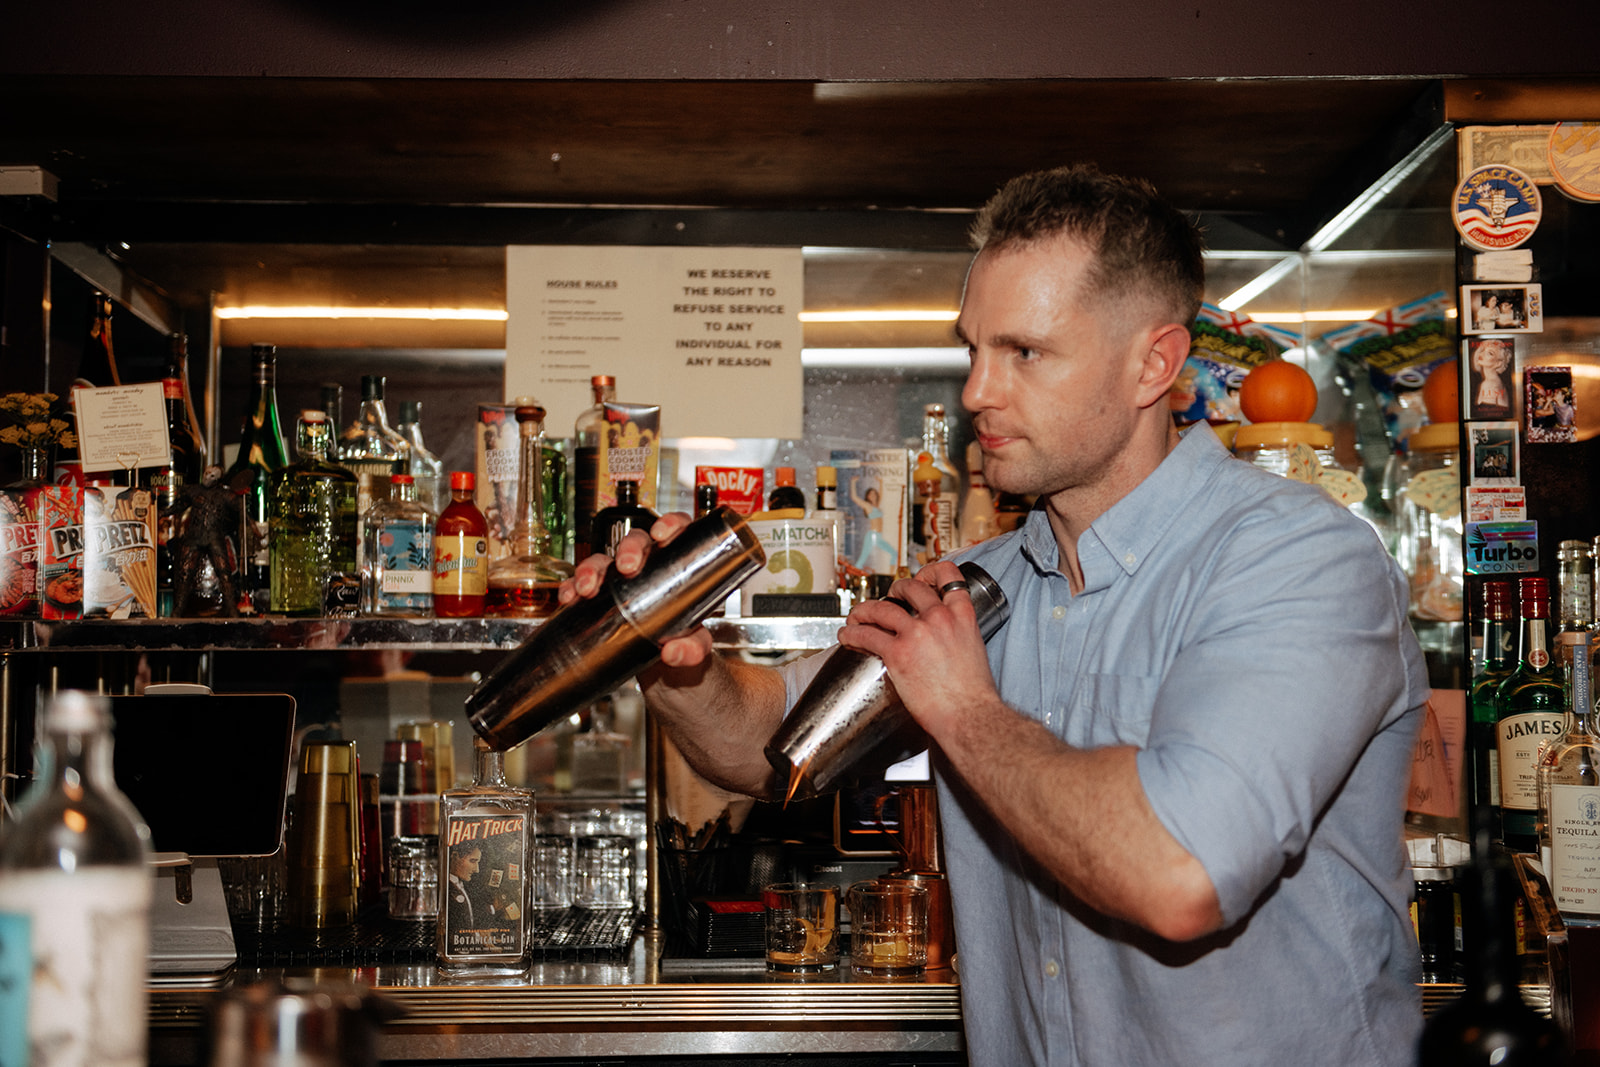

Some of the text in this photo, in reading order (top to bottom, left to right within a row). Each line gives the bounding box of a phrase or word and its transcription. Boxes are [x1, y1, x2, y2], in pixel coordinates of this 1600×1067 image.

[1471, 169, 1507, 187] SPACE
[1509, 172, 1536, 206] CAMP
[687, 269, 772, 279] WE RESERVE
[547, 280, 618, 289] HOUSE RULES
[683, 286, 776, 297] THE RIGHT TO
[673, 304, 785, 314] REFUSE SERVICE
[704, 322, 754, 331] TO ANY
[675, 339, 782, 349] INDIVIDUAL FOR
[686, 357, 772, 367] ANY REASON
[608, 448, 652, 457] FROSTED
[609, 456, 645, 464] COOKIE
[609, 464, 644, 472] STICKS
[488, 473, 519, 482] PEANU
[96, 522, 149, 553] PRETZ
[772, 527, 830, 541] MATCHA
[1469, 542, 1537, 562] Turbo
[1482, 562, 1526, 572] CONE
[385, 575, 415, 584] PINNIX
[1506, 720, 1562, 740] JAMES
[448, 818, 524, 847] HAT TRICK
[1556, 826, 1598, 837] TEQUILA
[1561, 886, 1586, 894] HECHO
[453, 933, 515, 945] BOTANICAL GIN
